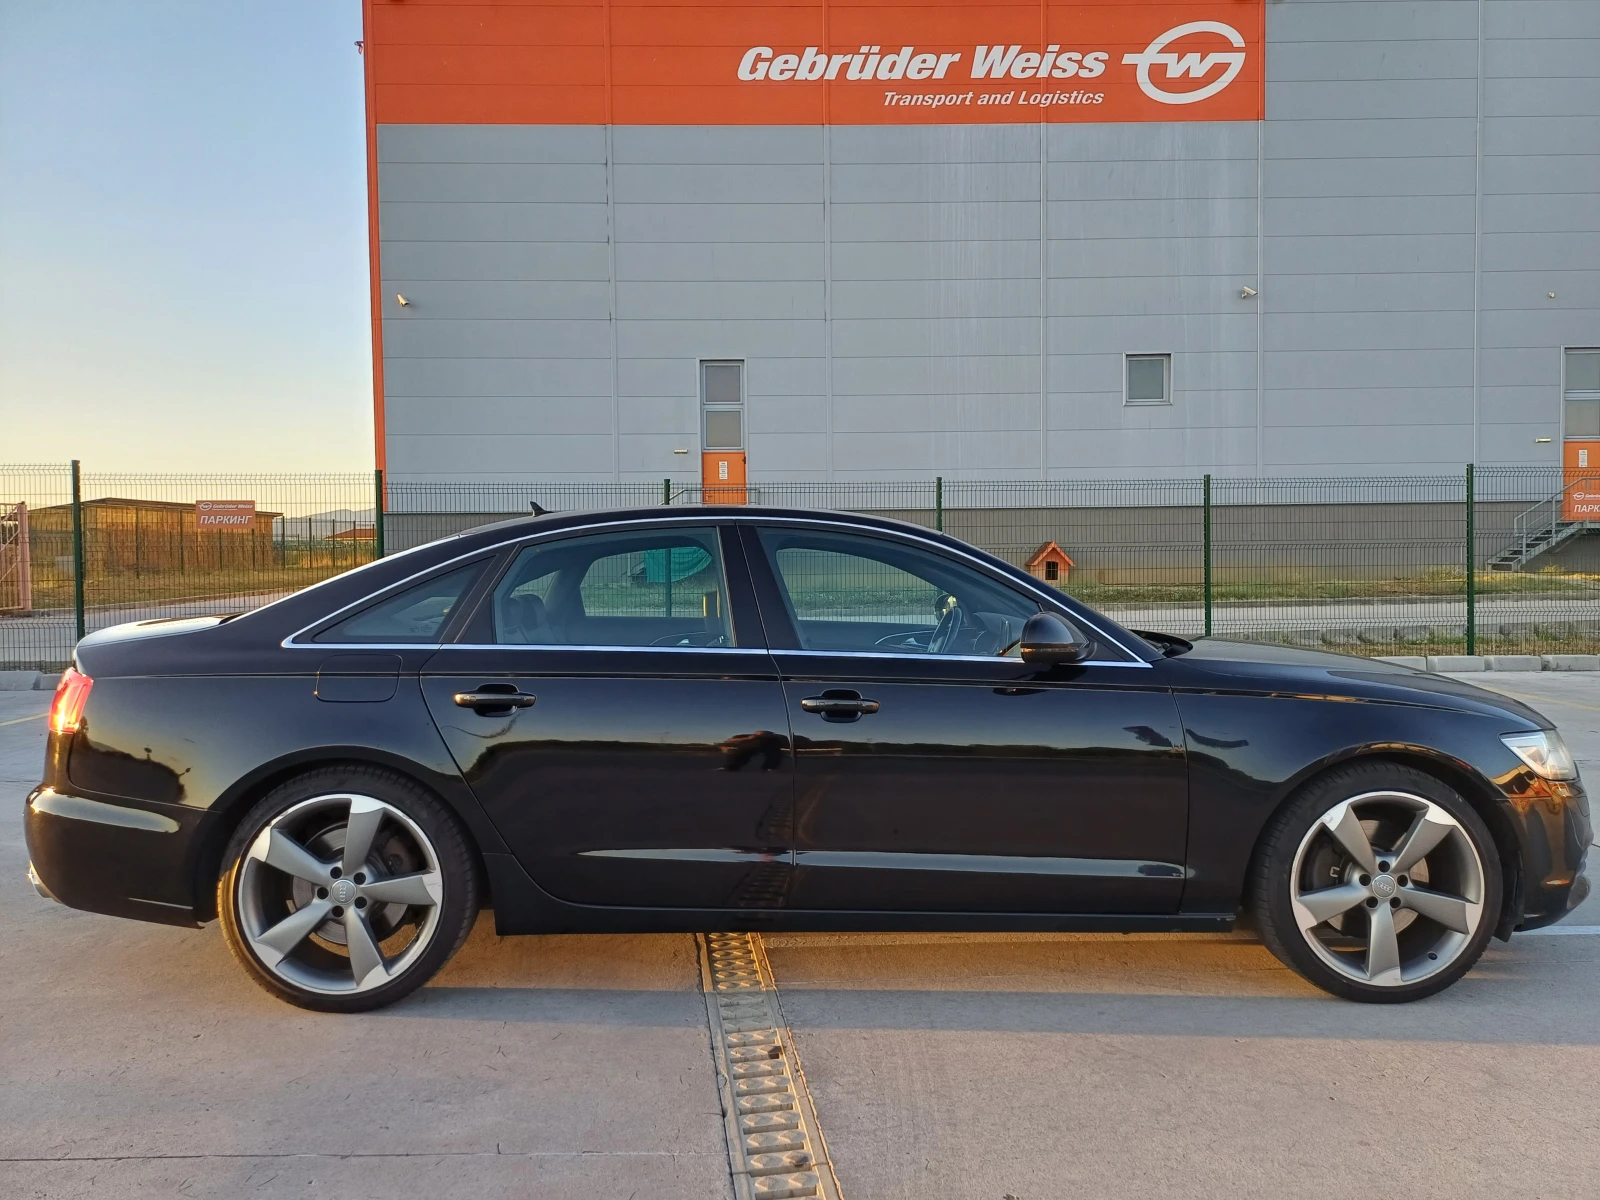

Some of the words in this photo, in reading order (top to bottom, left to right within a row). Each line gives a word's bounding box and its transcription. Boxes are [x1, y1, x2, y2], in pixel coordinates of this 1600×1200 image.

[737, 45, 962, 81] Gebrüder
[970, 44, 1110, 79] Weiss
[884, 91, 974, 108] Transport
[977, 90, 1015, 105] and
[1018, 90, 1105, 108] Logistics
[200, 515, 253, 524] ПАРКИНГ
